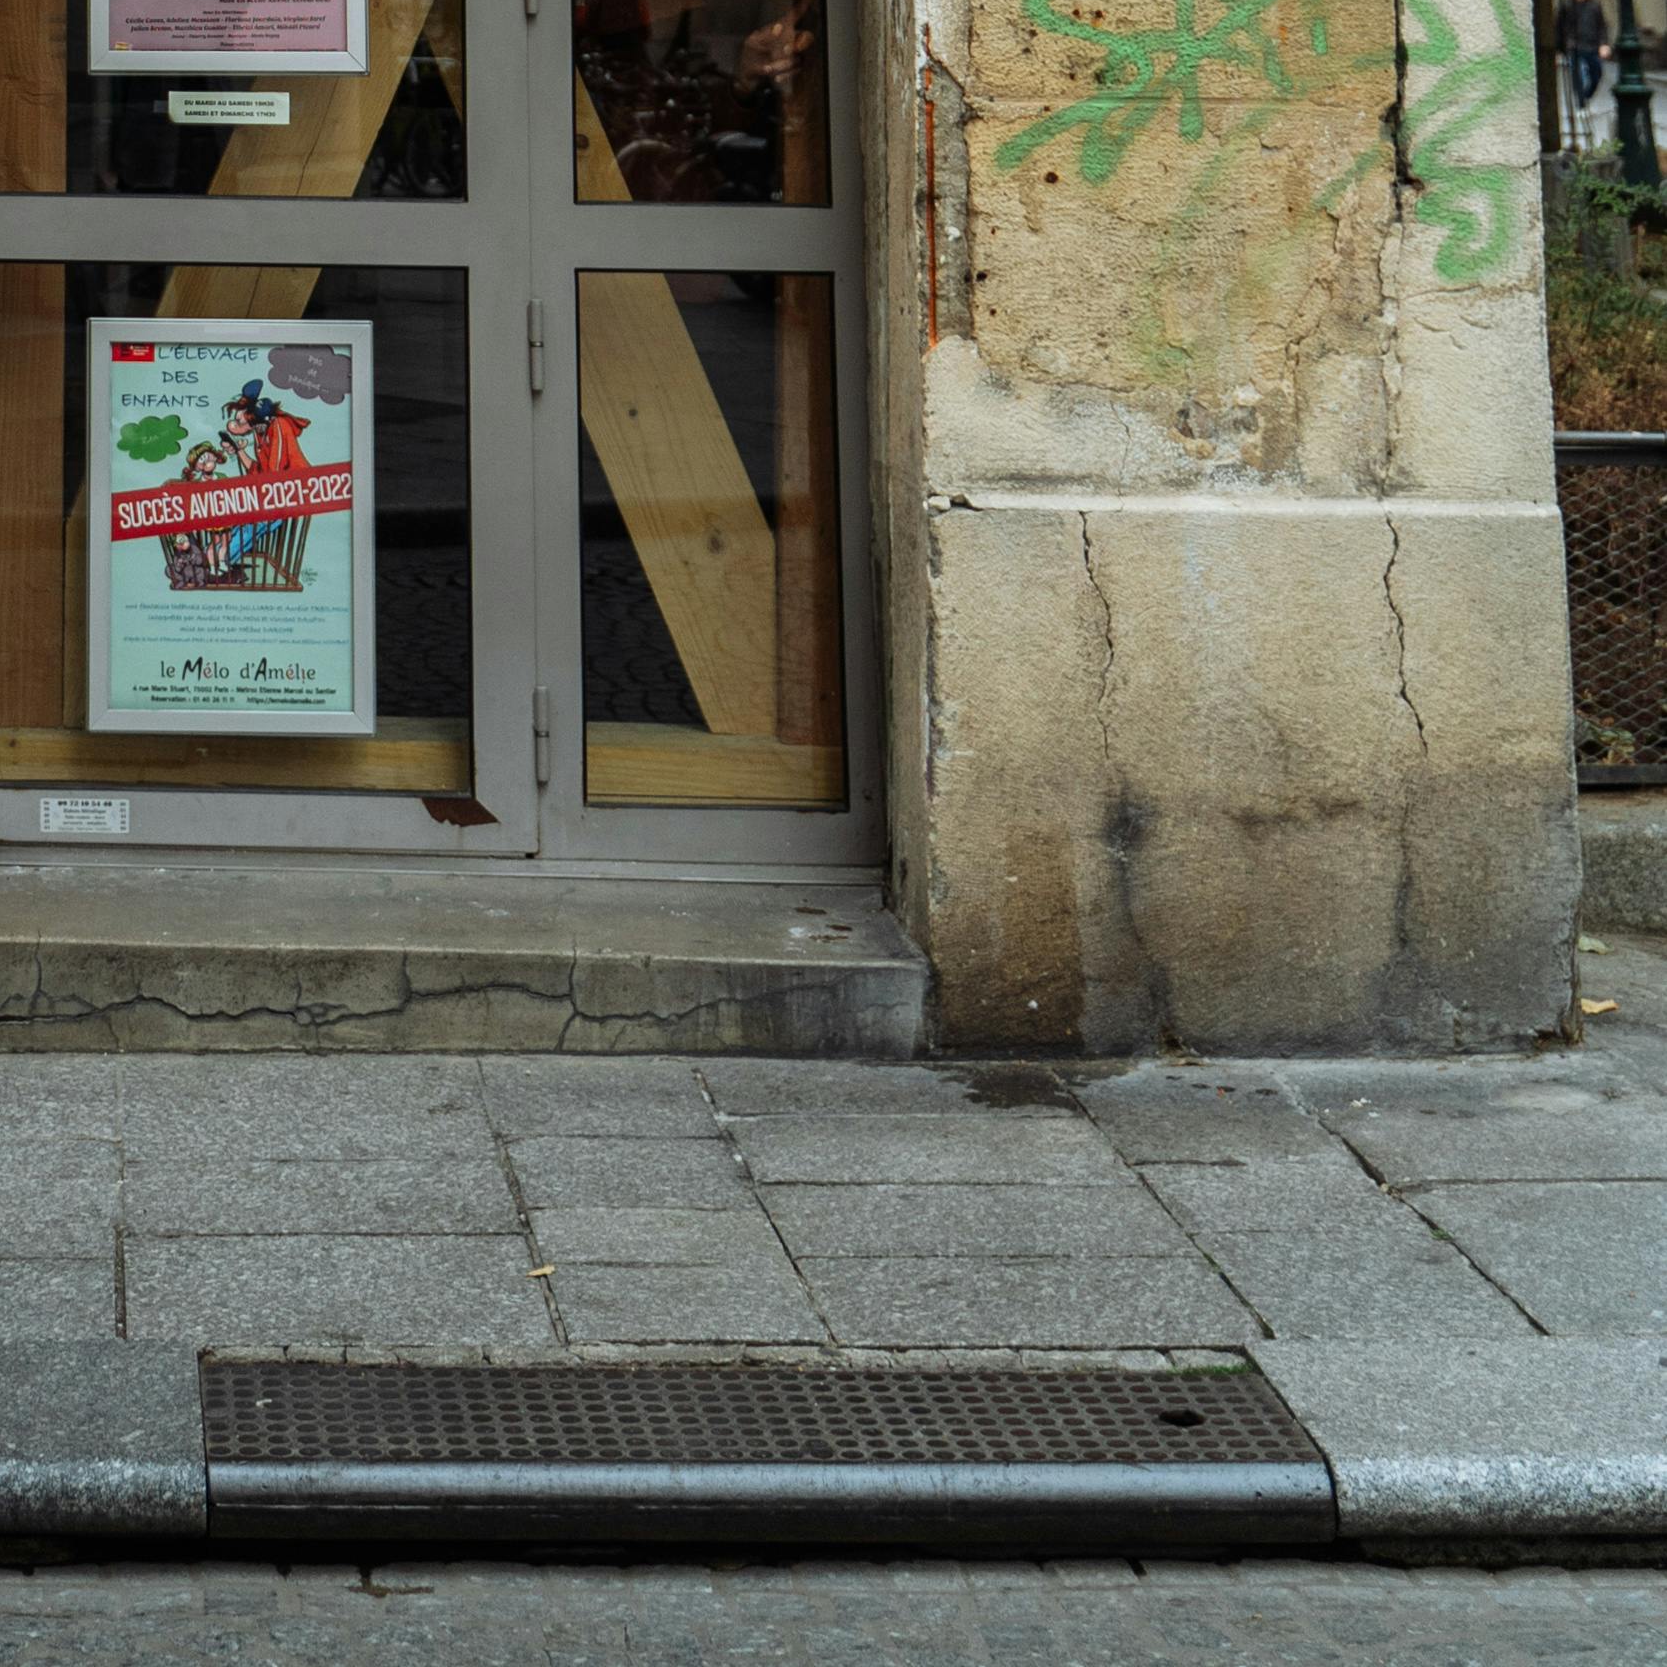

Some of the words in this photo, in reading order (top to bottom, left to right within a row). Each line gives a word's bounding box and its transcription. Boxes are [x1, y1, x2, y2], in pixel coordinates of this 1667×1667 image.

[162, 371, 199, 384] DES
[122, 393, 210, 408] ENFANTS
[118, 491, 184, 529] SUCCÈS
[190, 485, 260, 520] AVIGNON
[264, 473, 352, 510] 2021-2022
[160, 660, 175, 678] le
[182, 656, 230, 682] Mélo
[240, 657, 316, 684] d'Amélie
